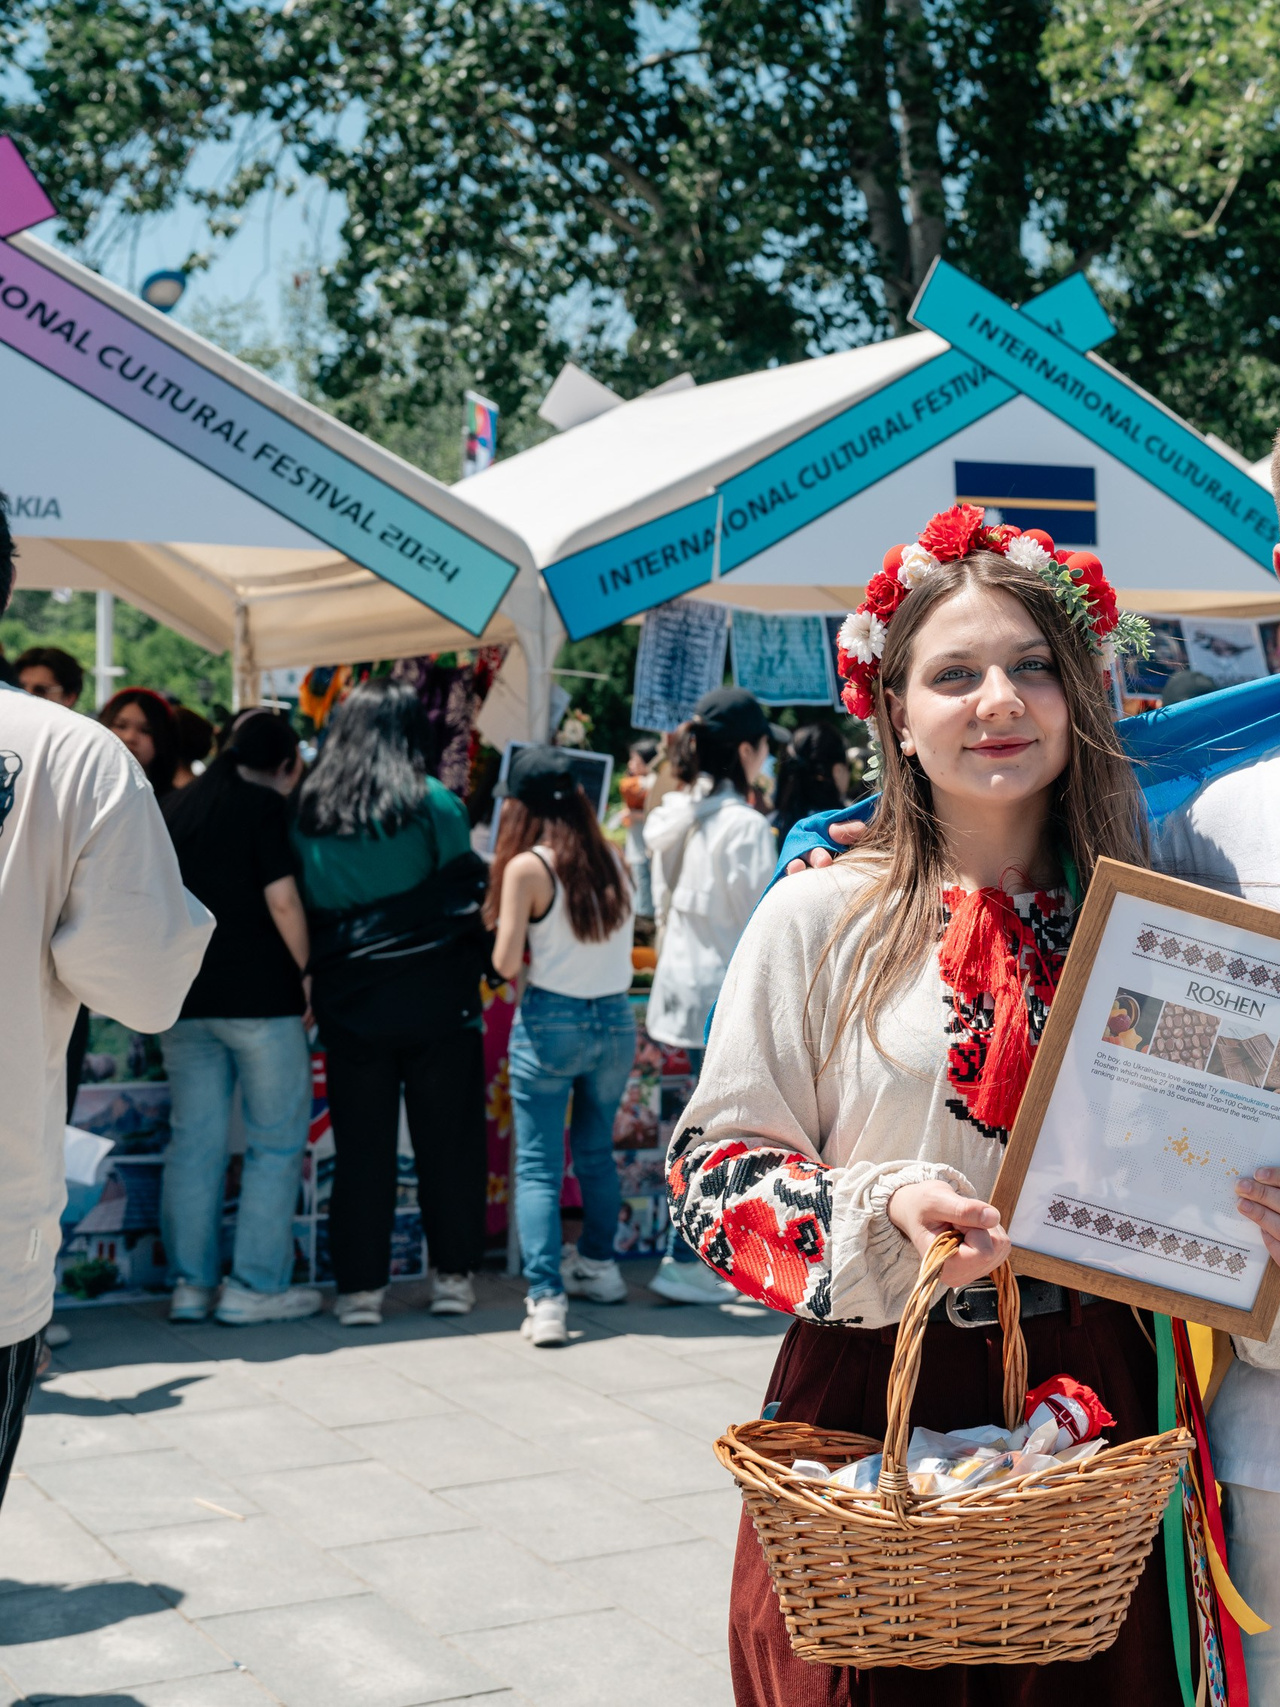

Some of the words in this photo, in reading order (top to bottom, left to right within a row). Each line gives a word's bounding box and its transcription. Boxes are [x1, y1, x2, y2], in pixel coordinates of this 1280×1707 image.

[0, 275, 91, 354] ONAL
[97, 345, 248, 453] CULTURAL
[252, 442, 376, 534] FESTIVAL
[378, 523, 461, 584] 2024
[968, 311, 1141, 444] INTERNATIONAL
[1144, 435, 1242, 518] CULTURAL
[598, 479, 798, 597] INTERNAIONAL
[797, 411, 913, 490] CULTURAL
[911, 364, 993, 424] FESTIVA
[1186, 981, 1266, 1018] ROSHEN
[1090, 1068, 1115, 1081] ranking
[1115, 1075, 1130, 1084] and
[1129, 1080, 1159, 1093] available
[1166, 1089, 1176, 1098] 35
[1176, 1094, 1206, 1107] countries
[1205, 1102, 1229, 1114] around
[1229, 1108, 1240, 1118] the
[1093, 1059, 1119, 1072] Roshen
[1120, 1067, 1139, 1078] which
[1139, 1074, 1158, 1084] ranks
[1158, 1078, 1168, 1086] 27
[1175, 1084, 1187, 1093] the
[1187, 1087, 1209, 1099] Global
[1210, 1093, 1237, 1107] Top-100
[1237, 1102, 1258, 1115] Candy
[1096, 1051, 1107, 1060] Oh
[1133, 1062, 1167, 1078] Ukrainians
[1167, 1073, 1181, 1082] love
[1182, 1079, 1207, 1090] sweets!
[1208, 1085, 1219, 1094] Try
[1219, 1089, 1270, 1109] #madeinukraine
